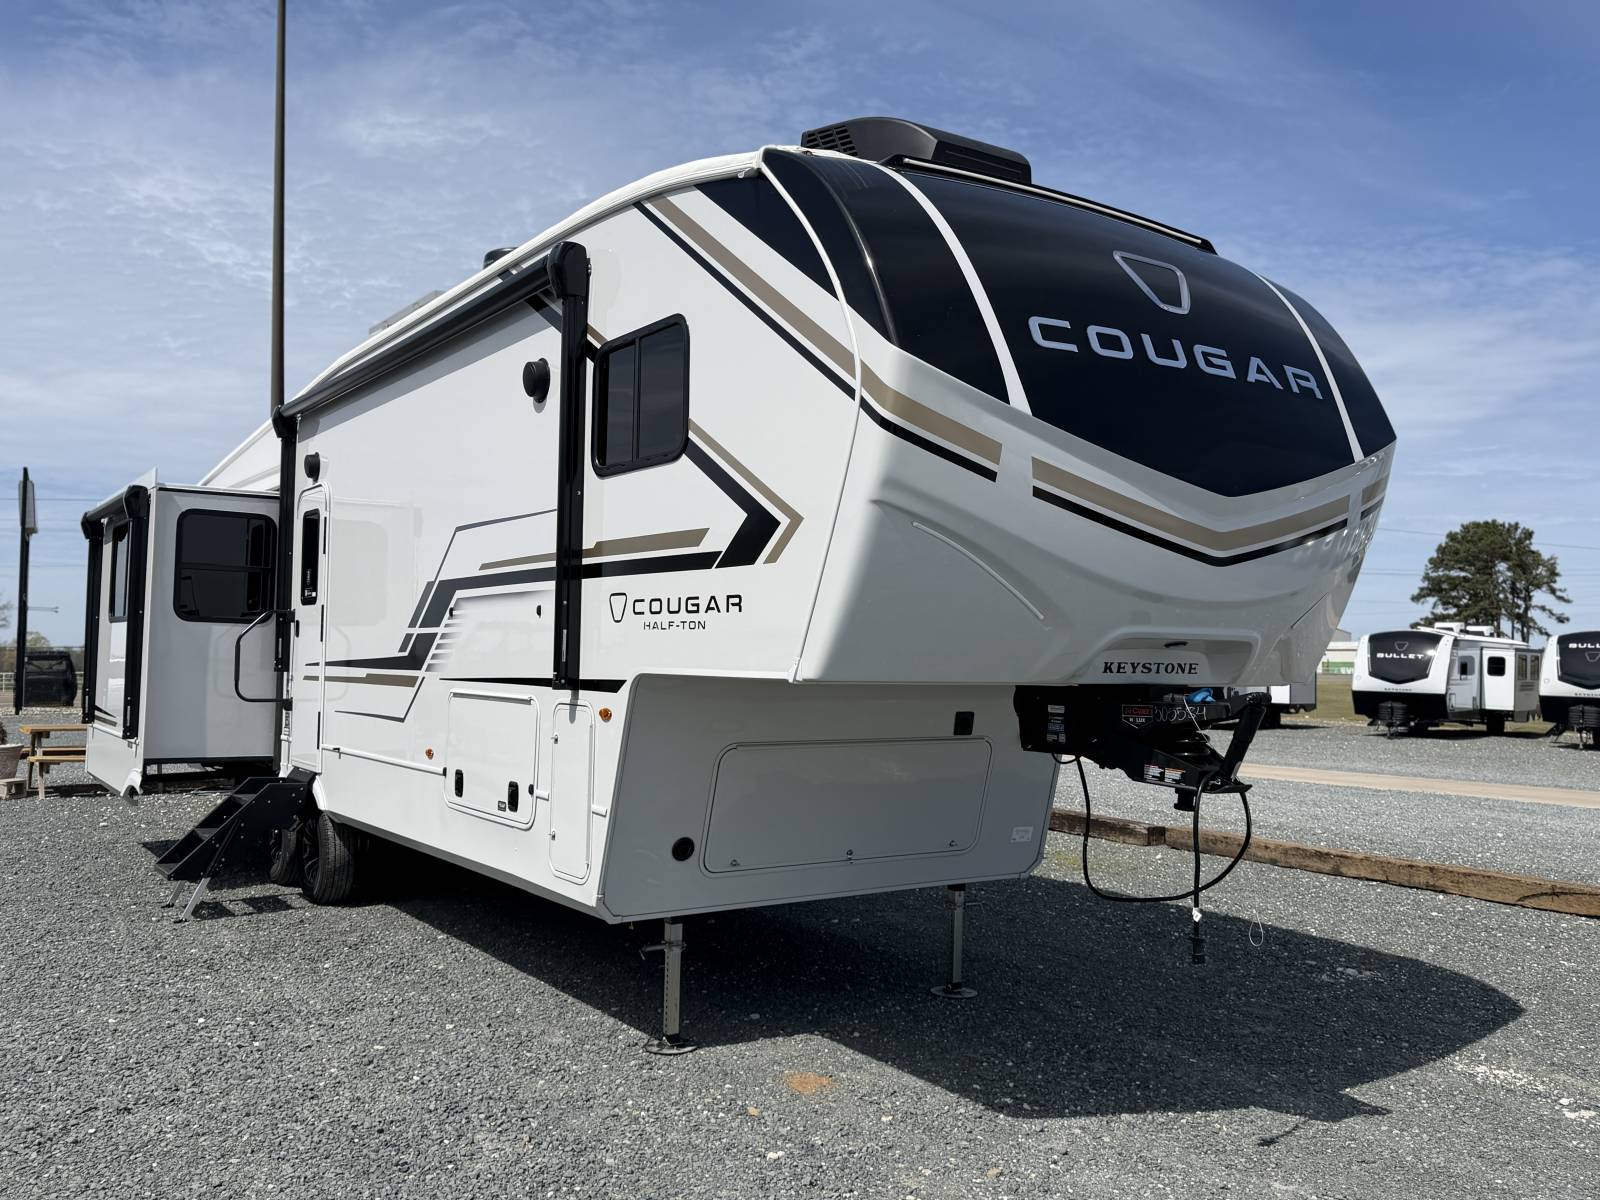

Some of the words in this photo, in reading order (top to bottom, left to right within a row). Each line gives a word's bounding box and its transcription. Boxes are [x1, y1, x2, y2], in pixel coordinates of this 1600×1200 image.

[1028, 316, 1324, 400] COUGAR
[632, 594, 743, 616] COUGAR
[643, 620, 706, 631] HALF-TON
[1102, 661, 1200, 675] KEYSTONE
